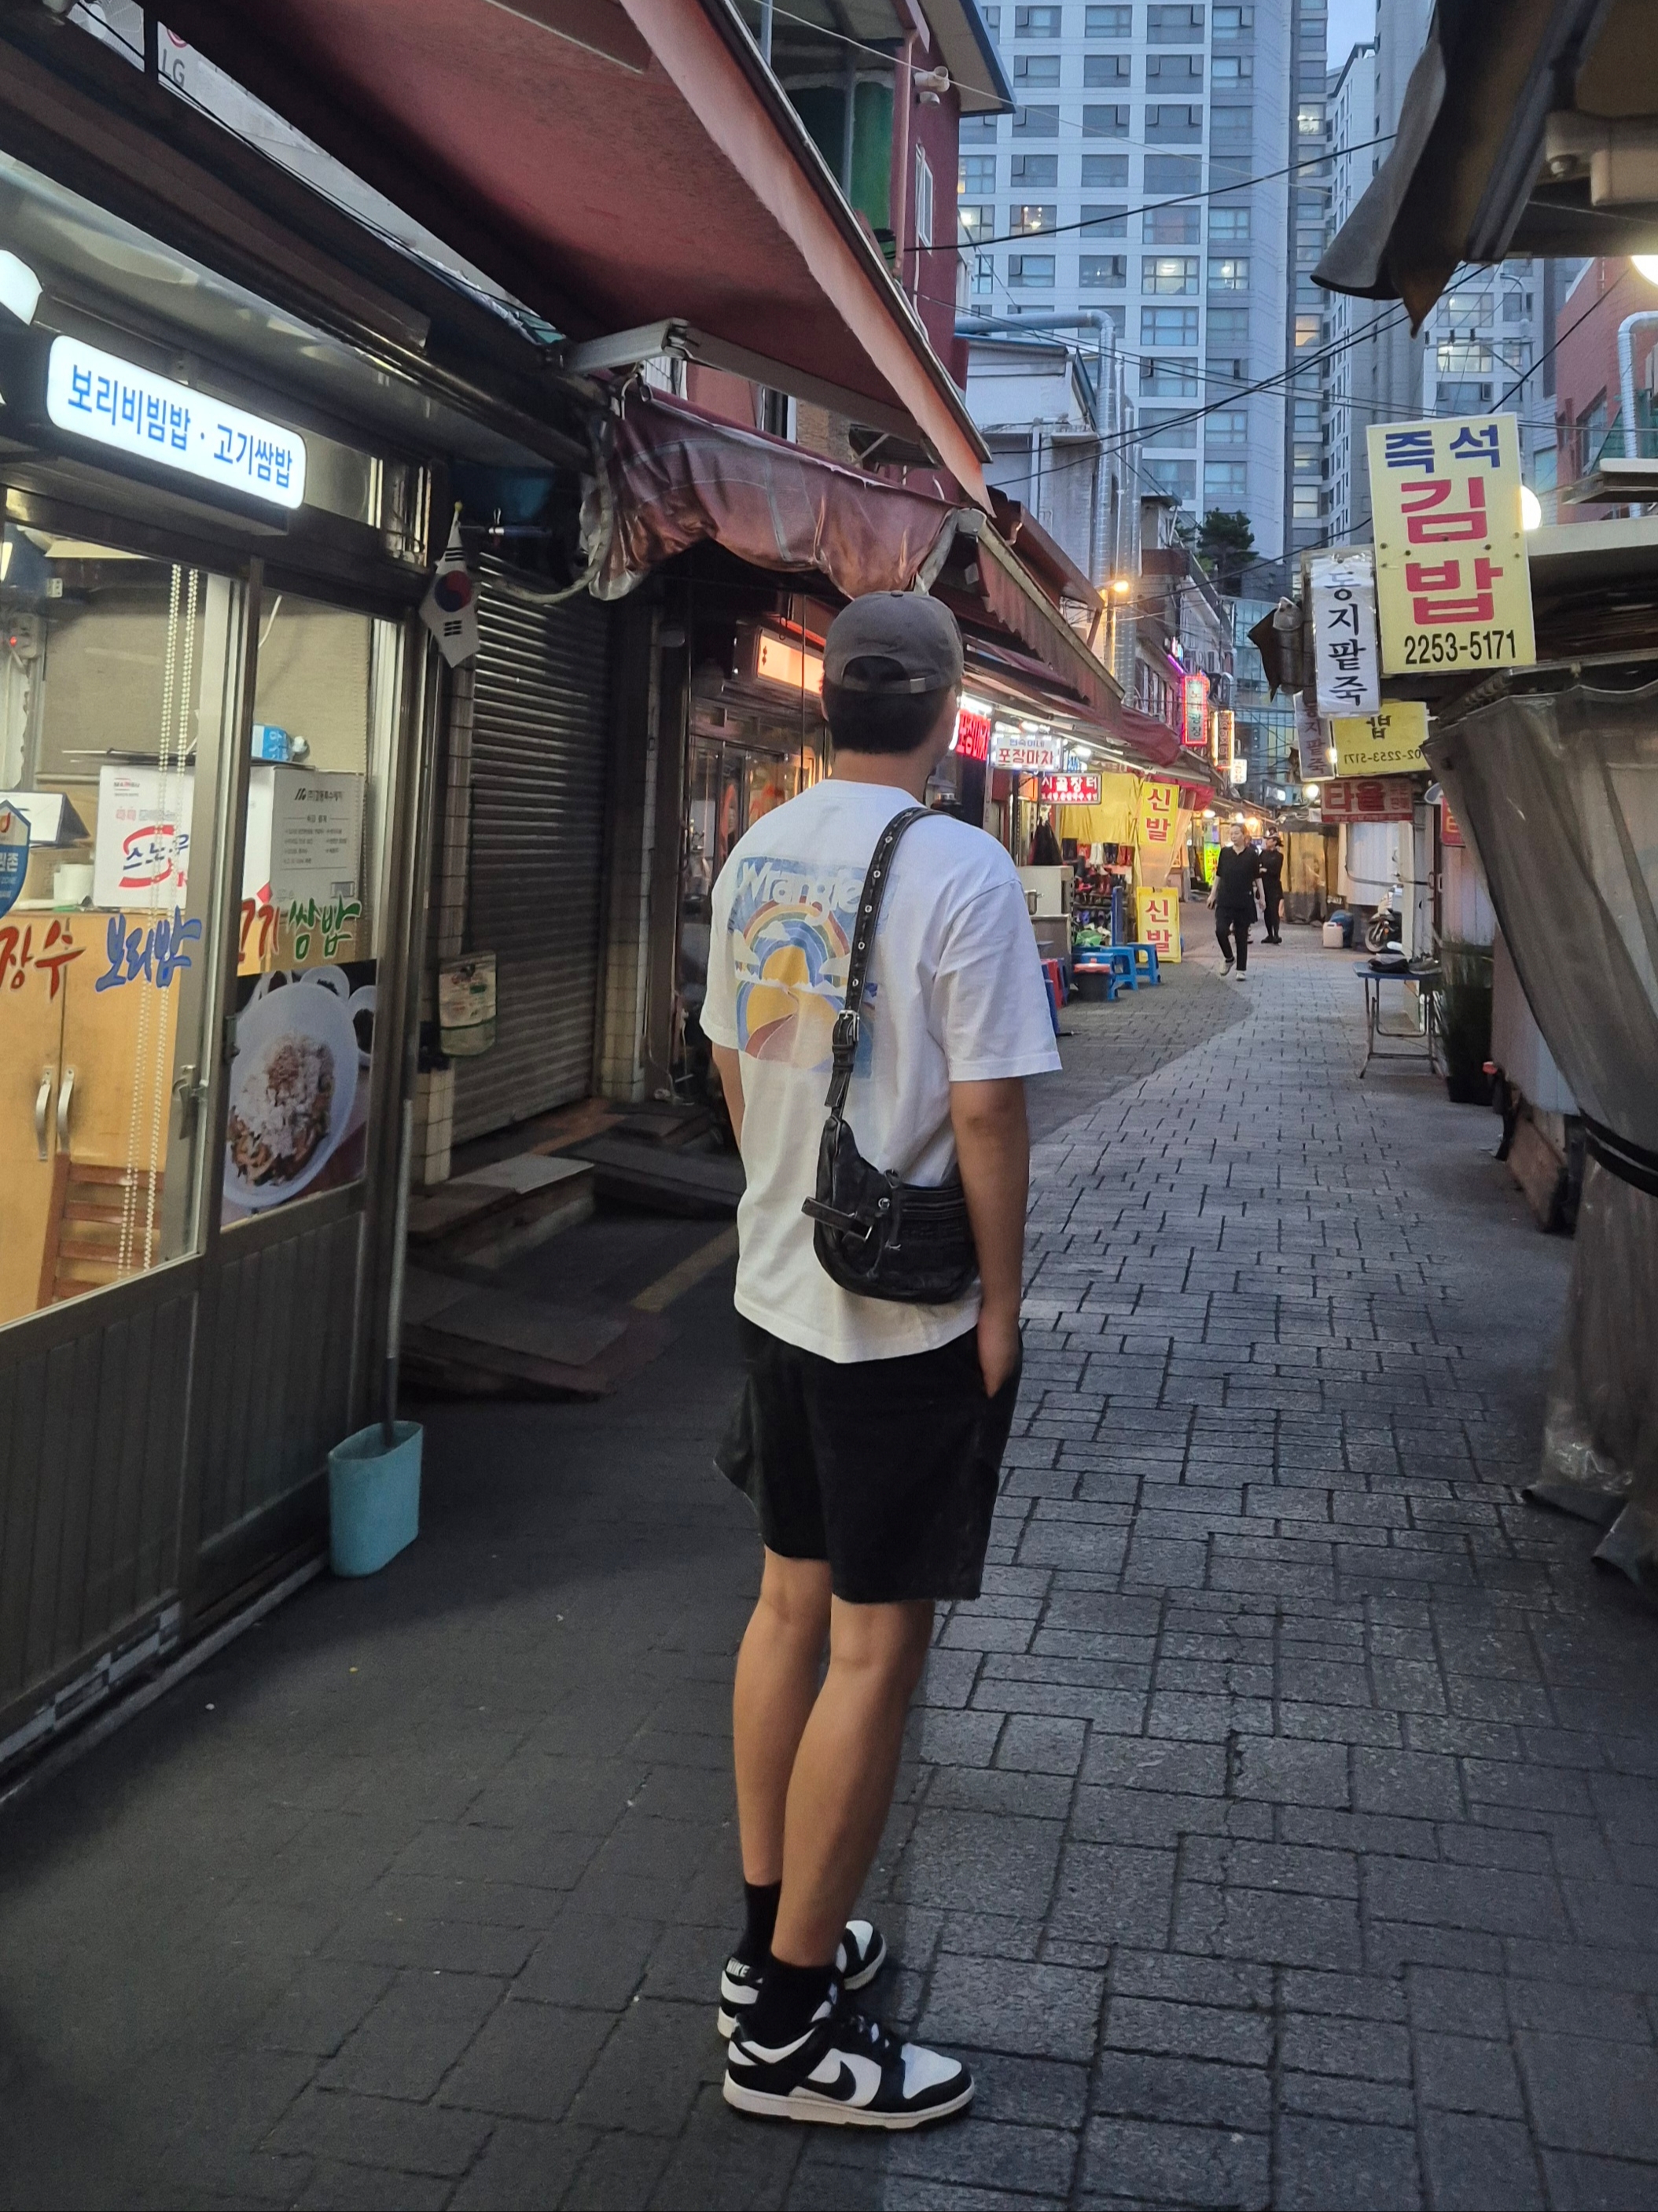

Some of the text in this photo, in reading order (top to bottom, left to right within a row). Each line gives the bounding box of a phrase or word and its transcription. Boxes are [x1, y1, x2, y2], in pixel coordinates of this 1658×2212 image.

[68, 364, 293, 488] 보리비빔밥 고기쌈밥
[1384, 424, 1501, 473] 즉석
[1401, 477, 1503, 625] 김밥
[1324, 571, 1369, 706] 동지팥죽
[1404, 630, 1517, 665] 2253-5171
[998, 748, 1054, 765] 포장마차
[1041, 775, 1097, 793] 시골장터
[1146, 789, 1171, 841] 신발
[743, 861, 866, 926] Wrangle
[95, 905, 203, 992] 보리밥
[288, 892, 362, 961] 쌈밥
[1145, 900, 1172, 953] 신발
